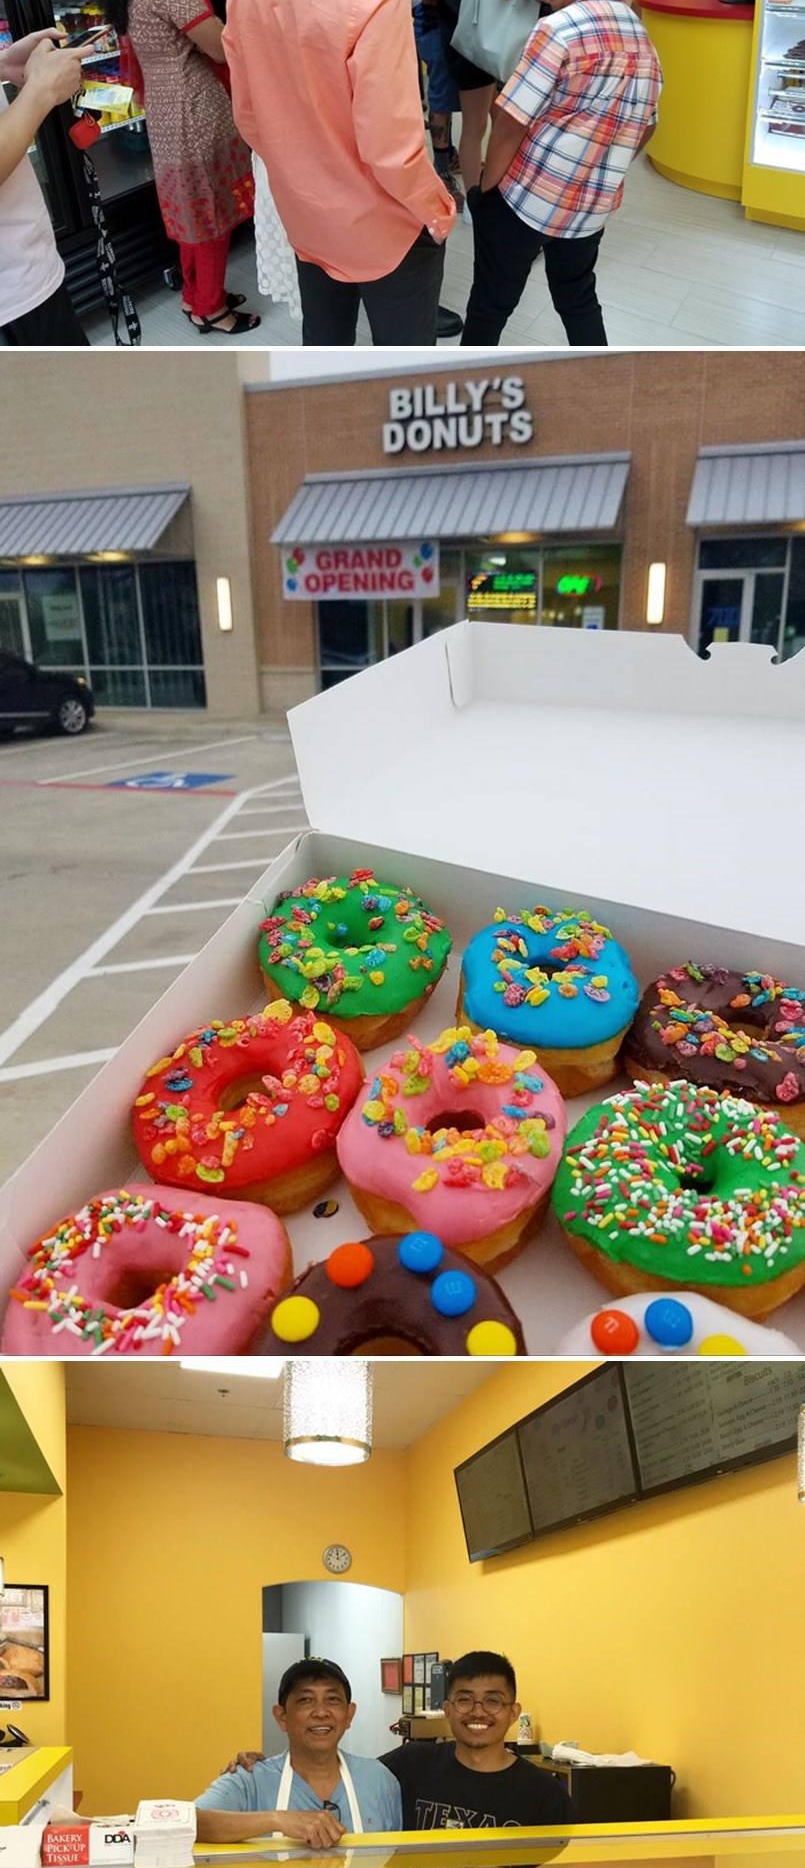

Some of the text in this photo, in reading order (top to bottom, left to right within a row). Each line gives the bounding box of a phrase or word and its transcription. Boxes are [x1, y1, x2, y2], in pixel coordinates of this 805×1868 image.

[389, 377, 525, 419] BILLY'S
[382, 410, 533, 453] DONUTS
[316, 548, 402, 571] GRAND
[304, 570, 415, 593] OPENING
[47, 1834, 82, 1843] BAKERY
[105, 1833, 130, 1843] DDA
[47, 1844, 86, 1853] PICK-UP
[47, 1854, 79, 1862] TISSUE
